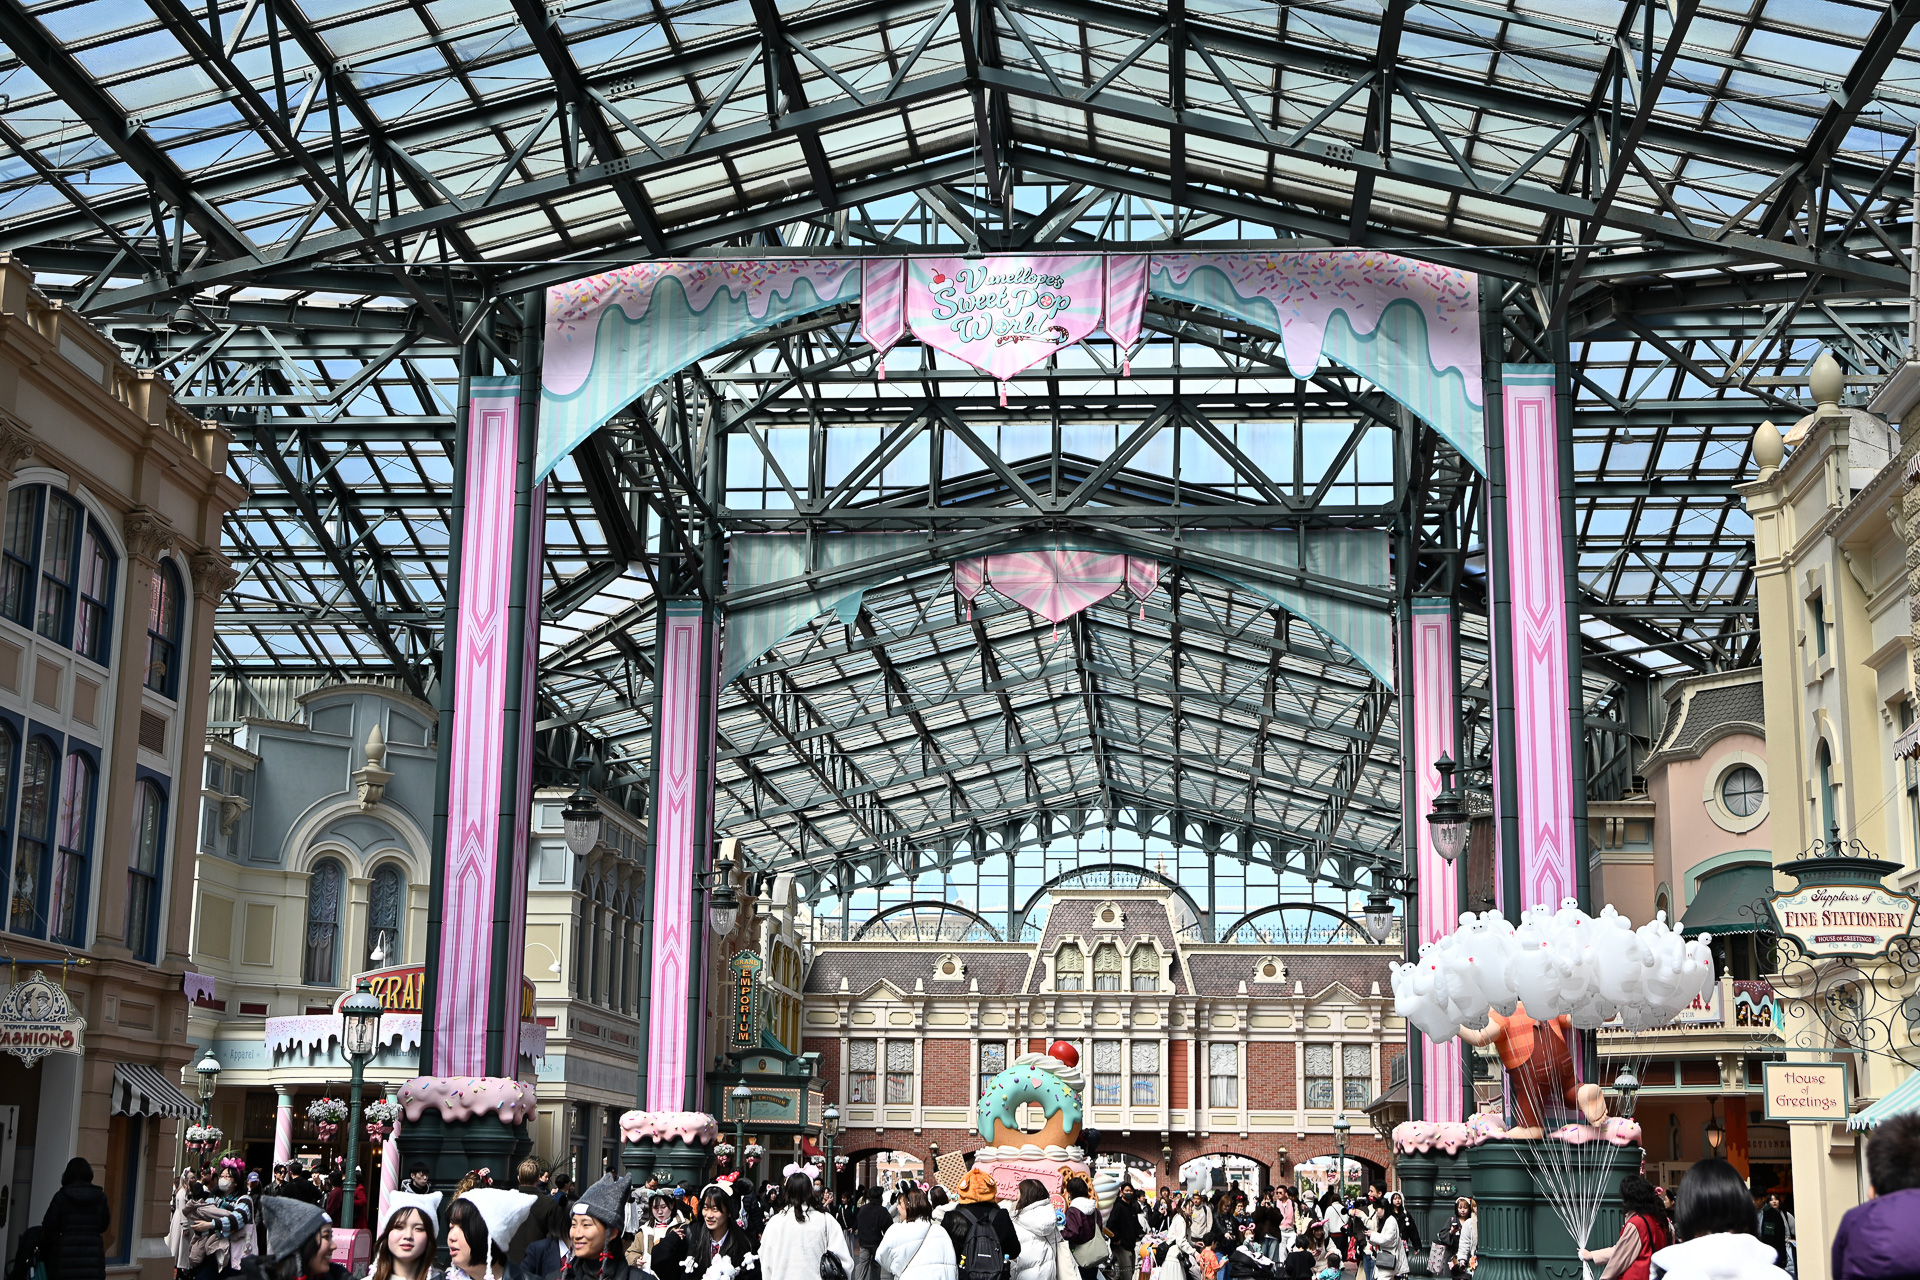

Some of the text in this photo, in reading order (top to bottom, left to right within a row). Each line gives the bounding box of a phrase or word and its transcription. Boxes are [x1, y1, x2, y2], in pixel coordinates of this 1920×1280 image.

[956, 266, 1064, 295] Vanellope's
[934, 287, 1071, 320] Sweet Pop
[950, 311, 1050, 343] World
[1811, 889, 1875, 908] Suppliers of
[1784, 910, 1905, 928] FINE STATIONERY
[1843, 935, 1872, 943] GREETINGS
[738, 969, 751, 1041] EMPORIUM
[0, 1030, 74, 1048] ASHIONS
[229, 1049, 255, 1061] Apparel
[1784, 1072, 1826, 1085] House
[1801, 1085, 1810, 1096] of
[1776, 1094, 1837, 1111] Greetings
